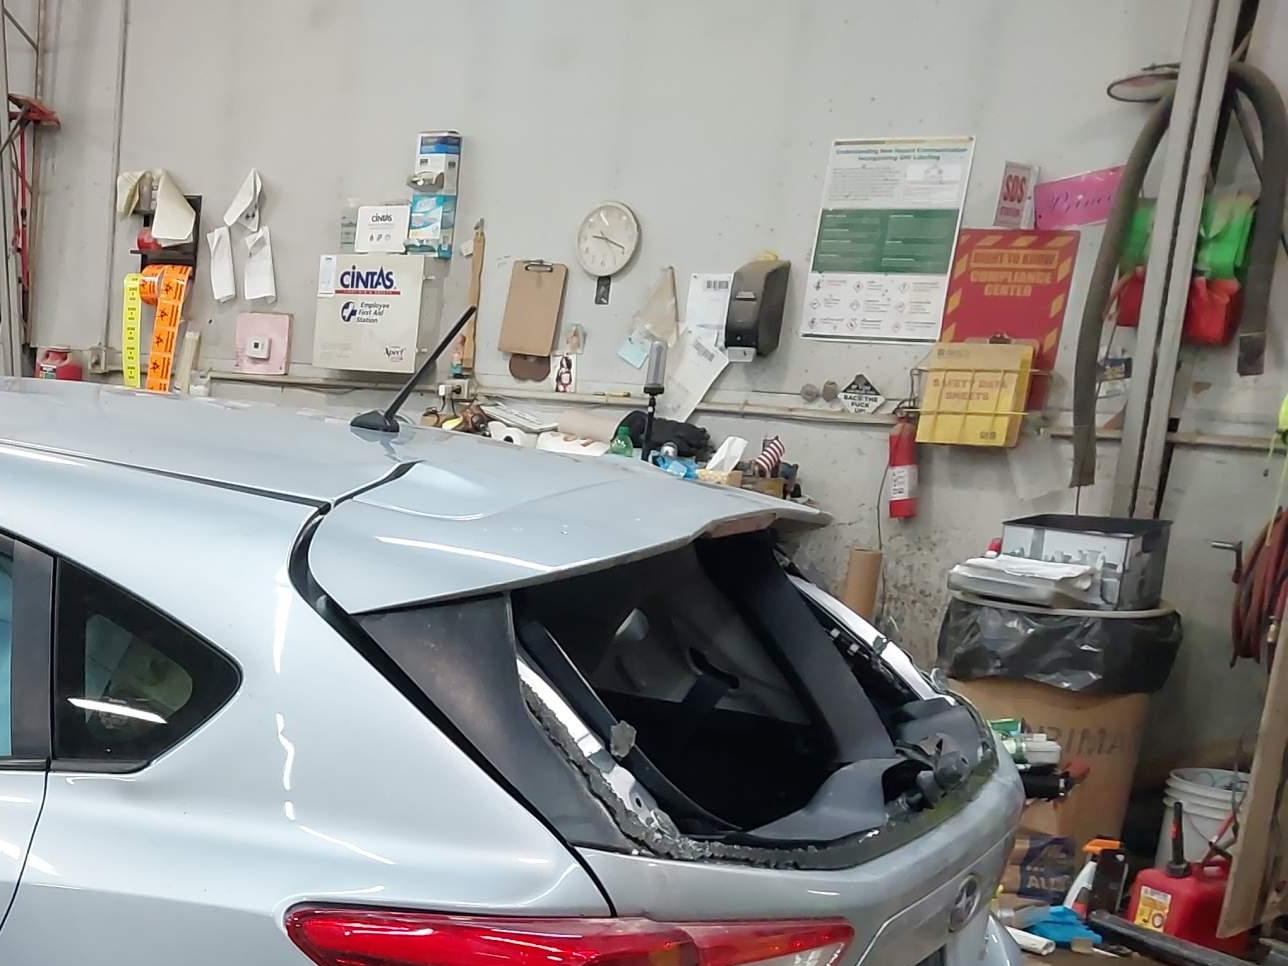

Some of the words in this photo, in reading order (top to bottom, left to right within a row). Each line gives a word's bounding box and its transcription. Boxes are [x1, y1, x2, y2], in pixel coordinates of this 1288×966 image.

[1003, 174, 1027, 203] SDS
[340, 265, 394, 289] CINTAS
[970, 270, 1051, 284] COMPLIANCE
[983, 284, 1033, 297] CENTER
[360, 301, 390, 310] Employee
